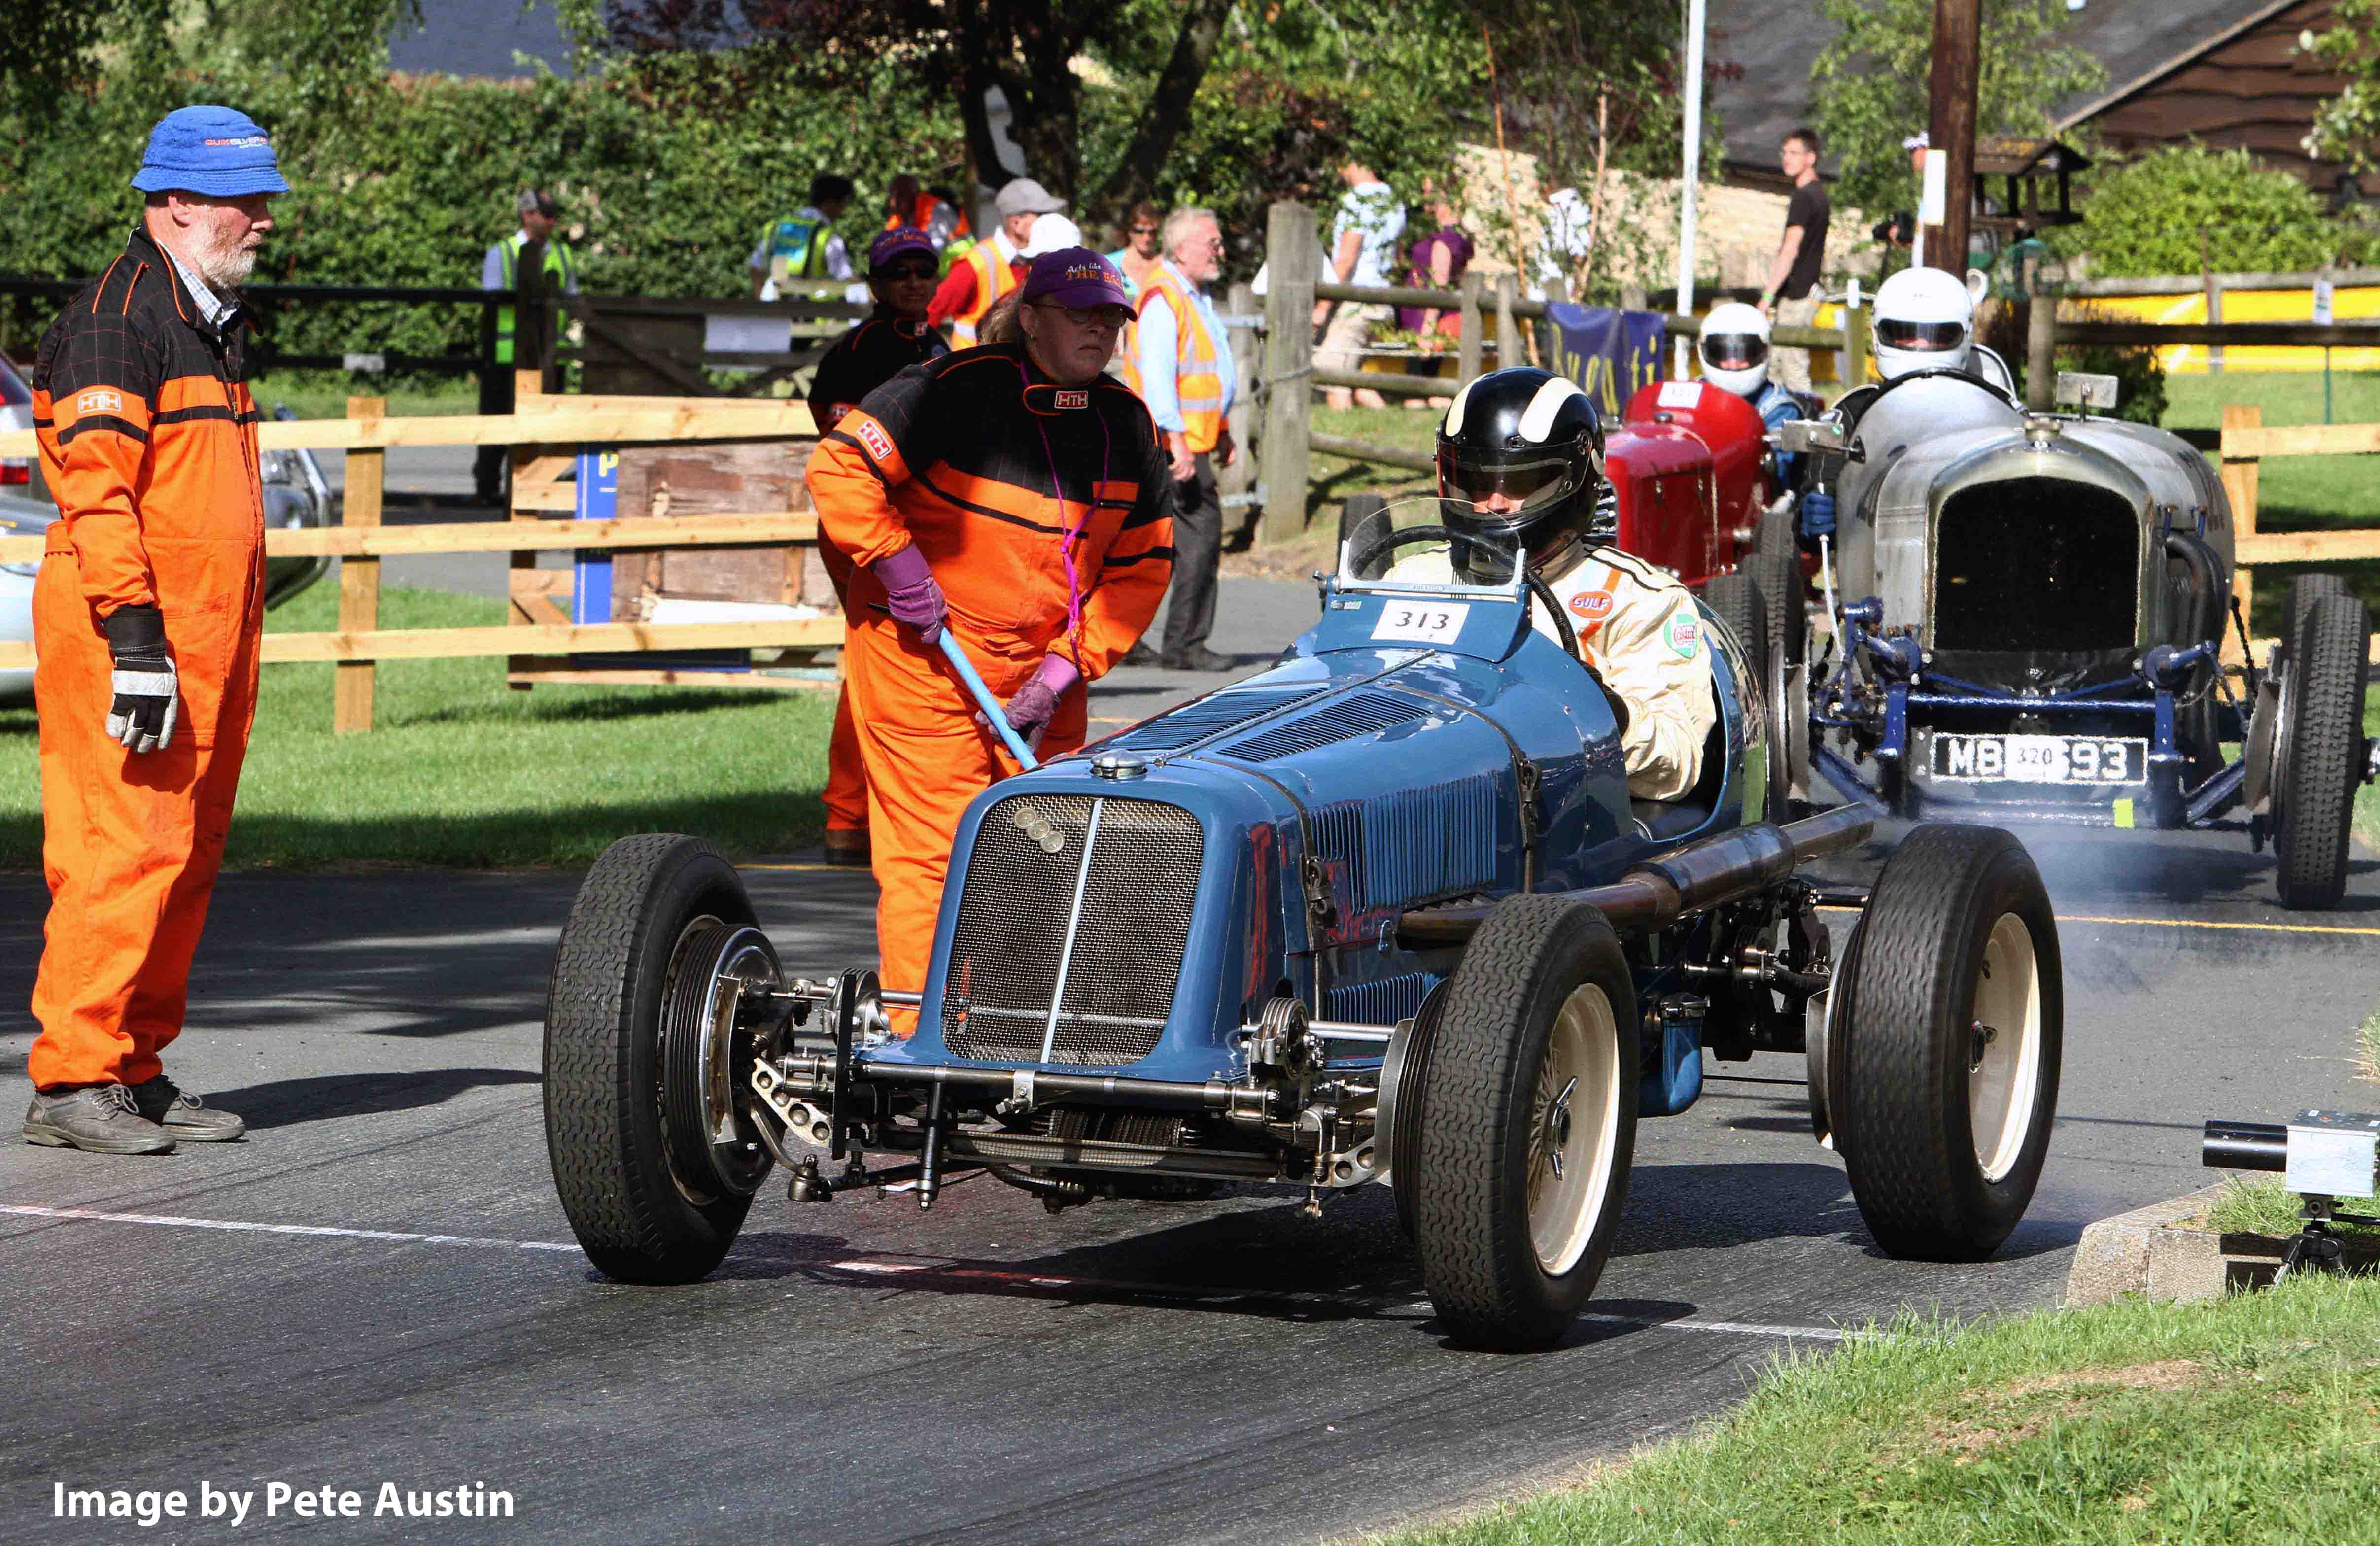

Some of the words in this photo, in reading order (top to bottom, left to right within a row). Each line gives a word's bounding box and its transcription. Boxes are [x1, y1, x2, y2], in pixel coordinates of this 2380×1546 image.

[205, 137, 260, 146] QUIKSILVER
[1065, 270, 1099, 281] THE
[79, 394, 120, 410] HTH
[1058, 394, 1087, 405] HTH
[1572, 597, 1610, 611] GULF
[1395, 611, 1449, 629] 313
[1948, 739, 2003, 775] MB
[2016, 747, 2054, 765] 320
